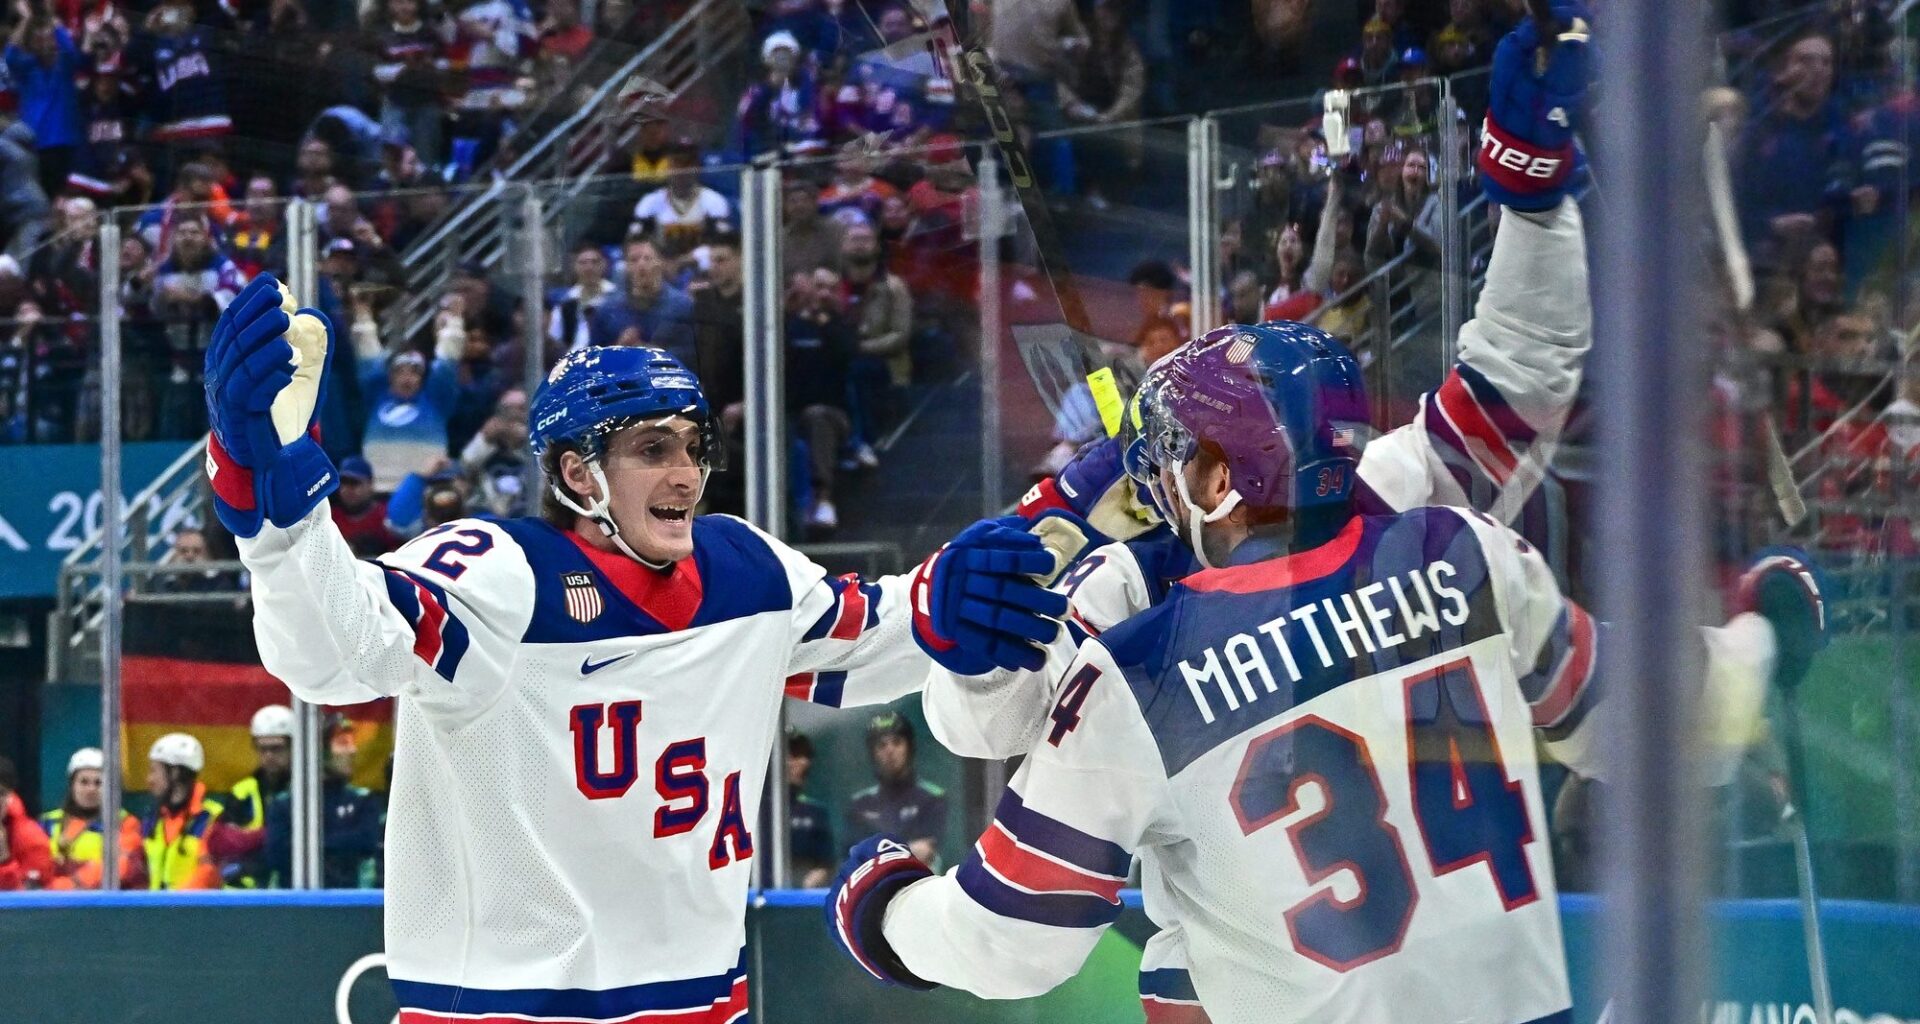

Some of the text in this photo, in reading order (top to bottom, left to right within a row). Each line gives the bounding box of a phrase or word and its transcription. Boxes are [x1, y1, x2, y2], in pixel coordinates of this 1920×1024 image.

[158, 51, 210, 91] USA
[1241, 334, 1257, 343] USA
[537, 407, 568, 431] CCM
[1316, 465, 1344, 497] 34
[566, 575, 591, 585] USA
[1177, 560, 1471, 724] MATTHEWS
[569, 700, 753, 871] USA
[1228, 656, 1542, 974] 34
